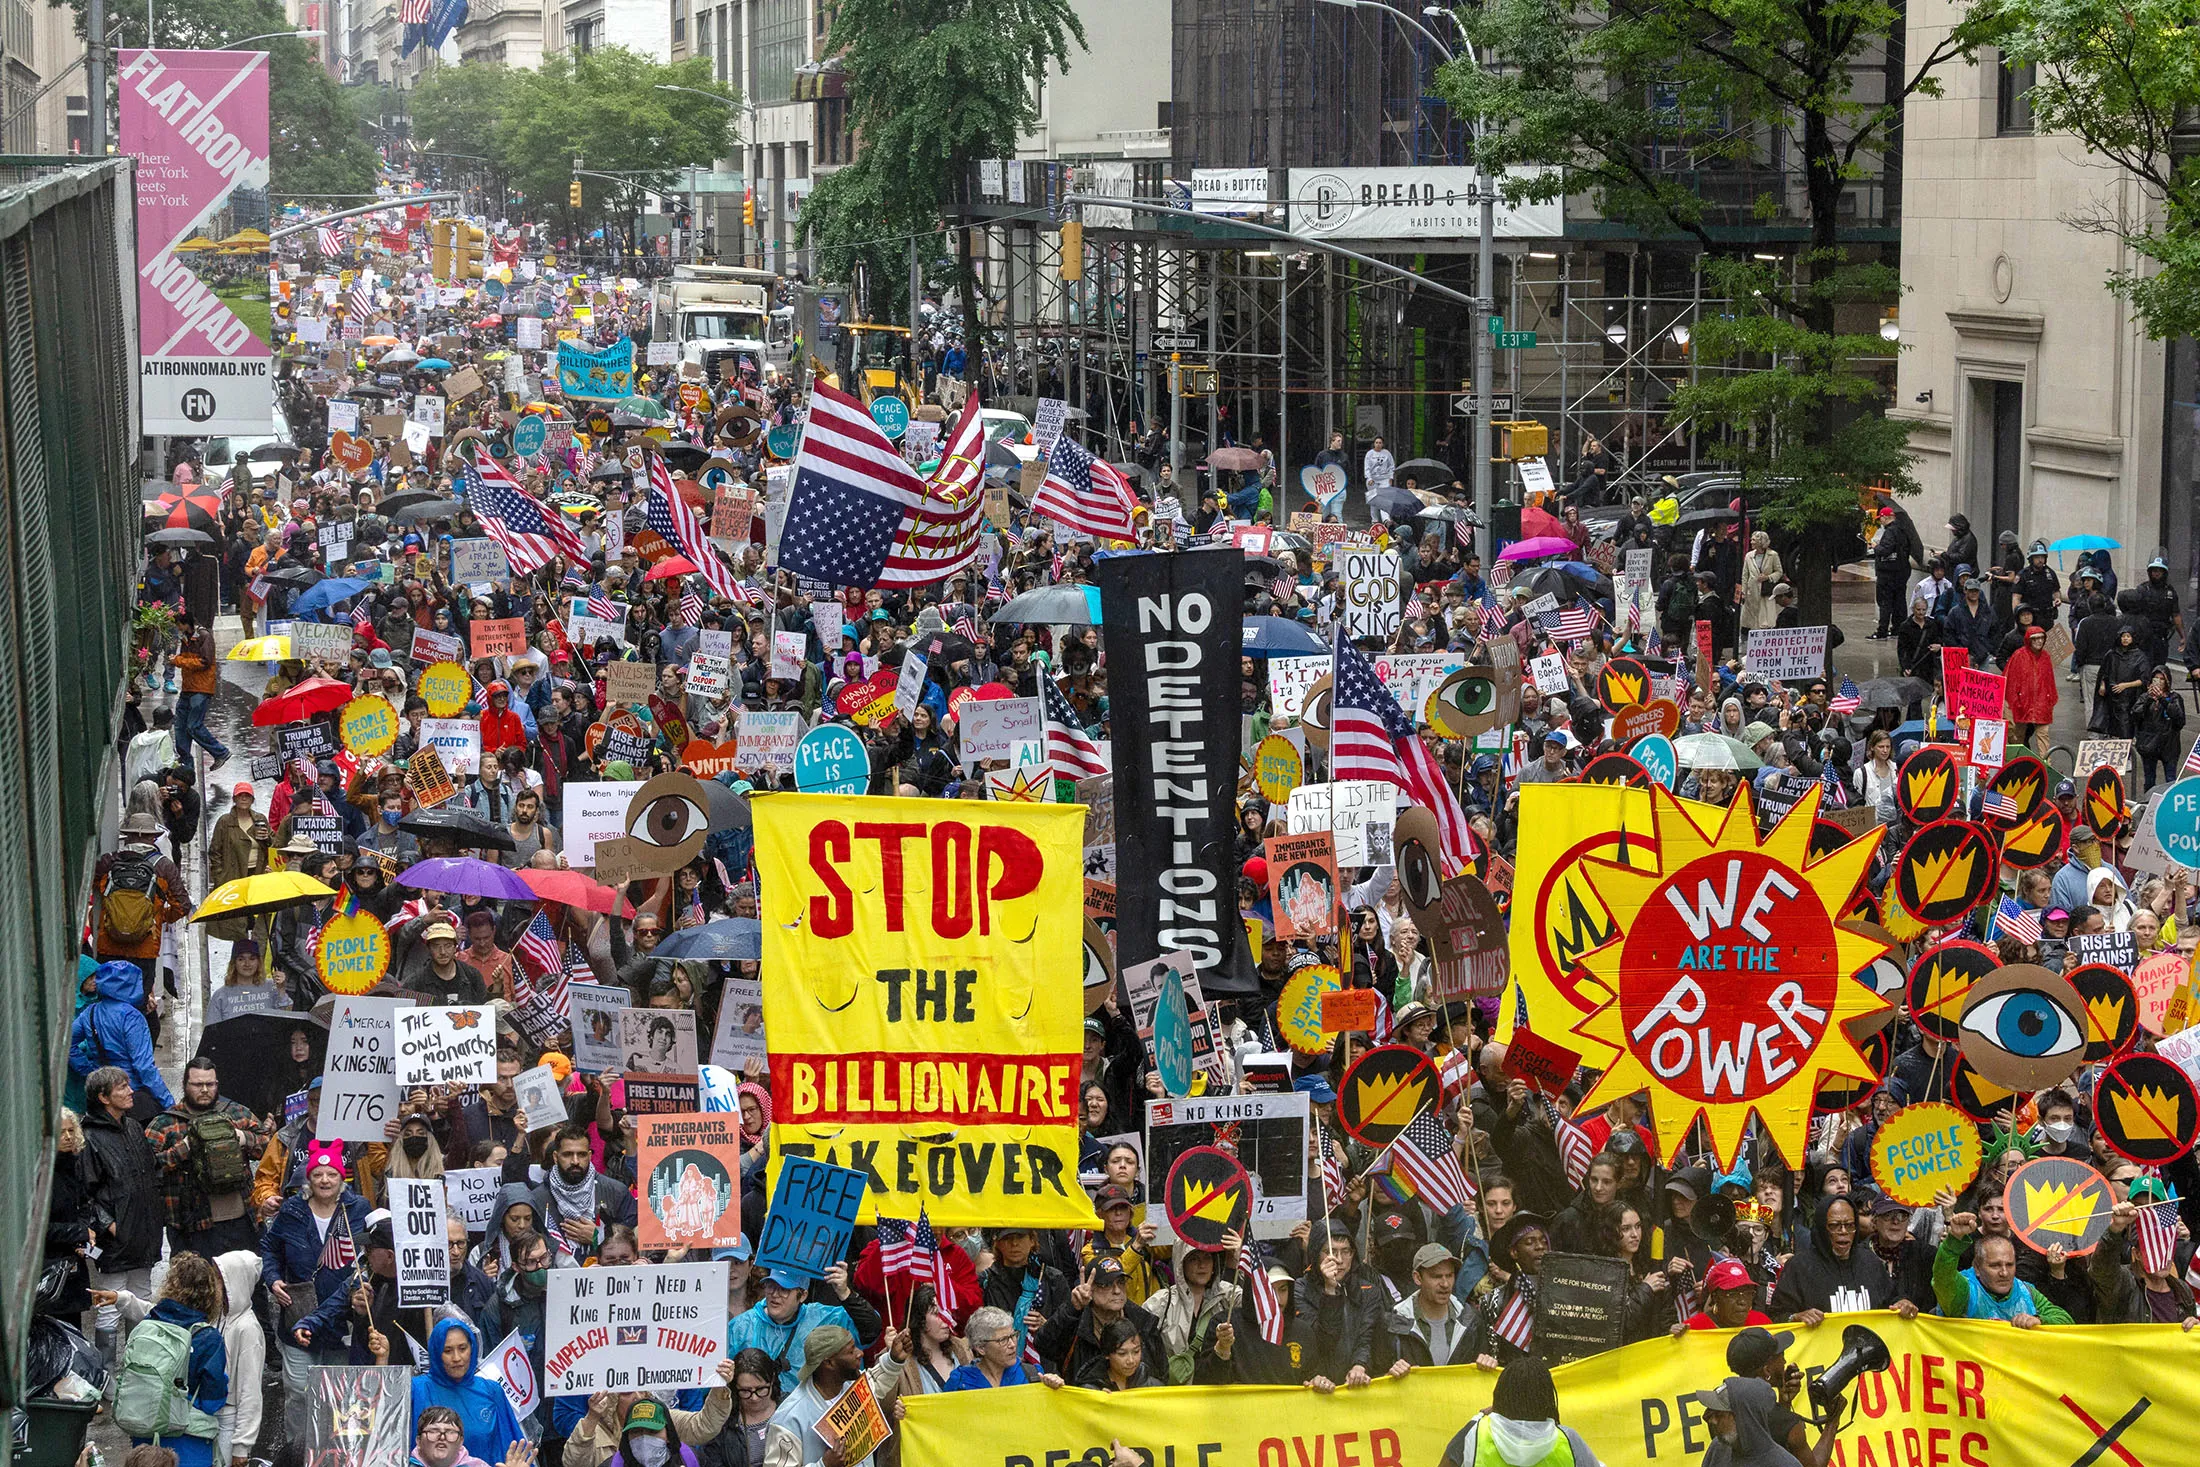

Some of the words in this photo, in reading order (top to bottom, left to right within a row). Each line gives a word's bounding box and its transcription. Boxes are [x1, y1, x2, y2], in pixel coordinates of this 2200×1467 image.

[121, 50, 258, 179] FLATIRON
[128, 152, 169, 165] Where
[160, 167, 188, 178] York
[1192, 179, 1221, 192] BREAD
[1232, 178, 1268, 192] BUTTER
[160, 194, 189, 206] York
[1361, 184, 1435, 207] BREAD
[1410, 217, 1446, 228] HABITS
[1450, 217, 1463, 227] TO
[1467, 217, 1479, 227] BE
[140, 254, 250, 356] NOMAD
[1502, 334, 1507, 346] E
[1511, 334, 1519, 346] 31
[560, 356, 629, 368] BILLIONAIRES
[186, 394, 211, 415] FN
[873, 404, 901, 413] PEACE
[1044, 399, 1061, 408] OUR
[885, 414, 894, 422] IS
[518, 424, 540, 434] PEACE
[517, 442, 538, 450] POWER
[342, 449, 360, 460] UNITE
[1315, 482, 1339, 494] UNITE
[1348, 556, 1399, 579] ONLY
[1628, 579, 1646, 587] SHIT
[1348, 577, 1399, 607] GOD
[1137, 593, 1212, 635] NO
[1368, 601, 1383, 613] IS
[294, 624, 350, 639] VEGANS
[1350, 612, 1399, 635] KING
[486, 642, 513, 653] RICH
[1765, 636, 1808, 647] PROTECT
[298, 647, 350, 660] FASCISM
[1749, 646, 1823, 657] CONSTITUTION
[1421, 658, 1444, 667] your
[1757, 658, 1781, 667] FROM
[1791, 657, 1809, 665] THE
[609, 665, 642, 679] NAZIS
[1388, 667, 1443, 679] HATE
[1539, 666, 1562, 677] BOMBS
[426, 678, 464, 692] PEOPLE
[693, 676, 716, 684] DEPORT
[1539, 681, 1566, 692] ISRAEL
[424, 691, 459, 704] POWER
[842, 680, 876, 708] HANDS
[347, 709, 388, 734] PEOPLE
[747, 714, 776, 725] HANDS
[1625, 706, 1665, 727] WORKERS
[285, 729, 312, 741] TRUMP
[304, 737, 324, 746] LORD
[352, 725, 388, 747] POWER
[611, 730, 633, 743] RISE
[636, 737, 650, 747] UP
[739, 735, 794, 747] IMMIGRANTS
[311, 743, 332, 755] FLIES
[608, 742, 649, 757] AGAINST
[802, 737, 853, 766] PEACE
[965, 739, 1010, 755] Dictator
[2082, 740, 2131, 751] FASCIST
[739, 753, 792, 764] SENATORS
[1262, 755, 1296, 774] PEOPLE
[1639, 748, 1671, 780] PEACE
[417, 755, 442, 800] COWARDICE
[427, 754, 452, 794] PREJUDICE
[1144, 641, 1223, 970] DETENTIONS
[1293, 791, 1331, 811] THIS
[582, 809, 619, 817] Becomes
[298, 818, 336, 829] DICTATORS
[1293, 814, 1325, 834] ONLY
[310, 831, 342, 841] DANGER
[320, 844, 336, 854] ALL
[1275, 838, 1326, 852] IMMIGRANTS
[1292, 850, 1310, 861] NEW
[808, 820, 1044, 939] STOP
[1664, 859, 1800, 944] WE
[326, 934, 378, 960] PEOPLE
[2081, 934, 2111, 950] RISE
[1678, 945, 1726, 970] ARE
[1737, 946, 1780, 972] THE
[2081, 947, 2133, 965] AGAINST
[328, 955, 375, 976] POWER
[2140, 961, 2183, 982] HANDS
[572, 992, 591, 1001] FREE
[595, 993, 625, 1005] DYLAN!
[730, 988, 751, 997] FREE
[876, 968, 978, 1023] THE
[338, 1007, 390, 1029] AMERICA
[402, 1015, 432, 1035] THE
[1631, 974, 1828, 1096] POWER
[353, 1036, 379, 1051] NO
[402, 1031, 441, 1056] ONLY
[423, 1035, 496, 1066] monarchs
[1513, 1042, 1552, 1069] FIGHT
[407, 1069, 434, 1084] WE
[441, 1061, 483, 1081] WANT
[1510, 1055, 1562, 1090] FASCISM
[629, 1085, 655, 1098] FREE
[658, 1086, 695, 1100] DYLAN
[792, 1060, 1071, 1118] BILLIONAIRE
[333, 1093, 384, 1121] 1776
[630, 1099, 652, 1111] FREE
[654, 1100, 674, 1112] THEM
[1186, 1106, 1205, 1120] NO
[1215, 1103, 1264, 1119] KINGS
[651, 1122, 726, 1133] IMMIGRANTS
[647, 1134, 668, 1146] ARE
[672, 1134, 695, 1146] NEW
[700, 1133, 733, 1145] YORK!
[1887, 1125, 1963, 1166] PEOPLE
[780, 1139, 1068, 1197] TAKEOVER
[1893, 1150, 1963, 1186] POWER
[461, 1178, 484, 1191] NO
[408, 1184, 432, 1208] ICE
[784, 1164, 862, 1222] FREE
[408, 1212, 436, 1236] OUT
[722, 1237, 737, 1245] NYIC
[764, 1215, 848, 1262] DYLAN
[403, 1248, 420, 1268] OF
[425, 1248, 445, 1268] OUR
[575, 1278, 594, 1297] WE
[607, 1276, 642, 1297] DON'T
[656, 1275, 686, 1295] NEED
[1592, 1283, 1611, 1292] PEOPLE
[570, 1305, 598, 1325] KING
[608, 1304, 641, 1323] FROM
[652, 1302, 698, 1322] QUEENS
[657, 1327, 717, 1359] TRUMP
[545, 1326, 610, 1379] IMPEACH
[565, 1371, 594, 1391] SAVE
[606, 1369, 629, 1388] OUR
[1859, 1353, 1986, 1418] OVER
[1258, 1427, 1403, 1467] OVER
